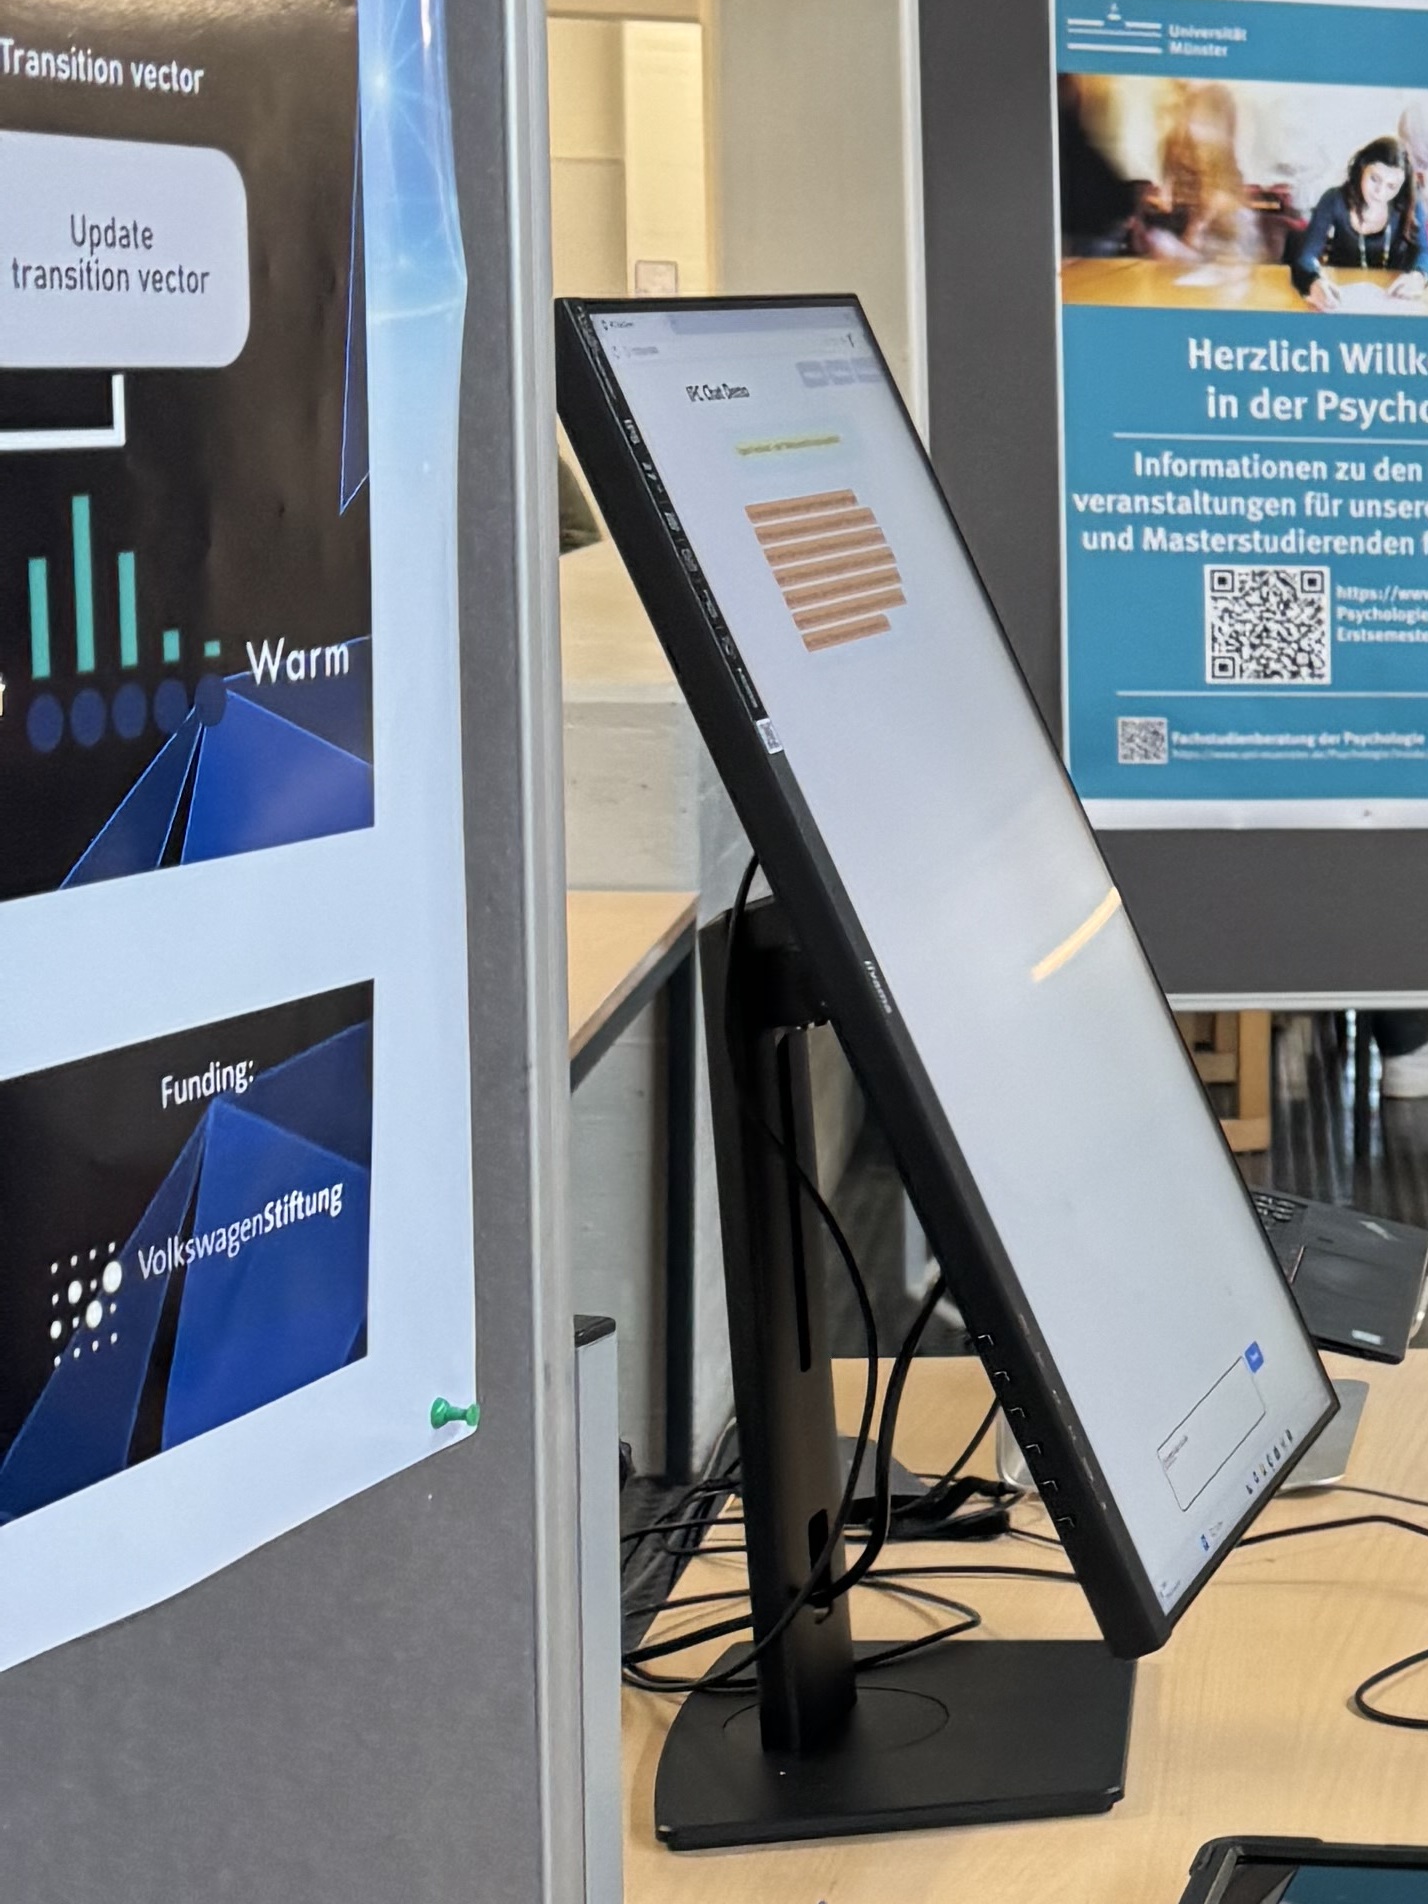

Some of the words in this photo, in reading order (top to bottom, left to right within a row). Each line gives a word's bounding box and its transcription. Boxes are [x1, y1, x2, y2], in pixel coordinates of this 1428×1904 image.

[1168, 24, 1247, 42] Universität
[1168, 41, 1228, 57] Münster
[0, 37, 123, 86] Transition
[130, 60, 204, 95] vector
[70, 213, 154, 258] Update
[12, 257, 130, 292] transition
[138, 264, 210, 295] vector
[1188, 337, 1330, 373] Herzlich
[1207, 386, 1238, 419] in
[1250, 387, 1308, 420] der
[1133, 451, 1328, 481] Informationen
[1335, 461, 1366, 481] zu
[1373, 456, 1423, 482] den
[1072, 489, 1296, 521] veranstaltungen
[1304, 491, 1343, 517] für
[1082, 525, 1133, 551] und
[1142, 526, 1414, 556] Masterstudierenden
[246, 637, 350, 686] Warm
[1318, 732, 1341, 745] der
[1344, 731, 1425, 747] Psychologie
[161, 1060, 254, 1109] Funding:
[137, 1182, 343, 1280] VolkswagenStiftung
